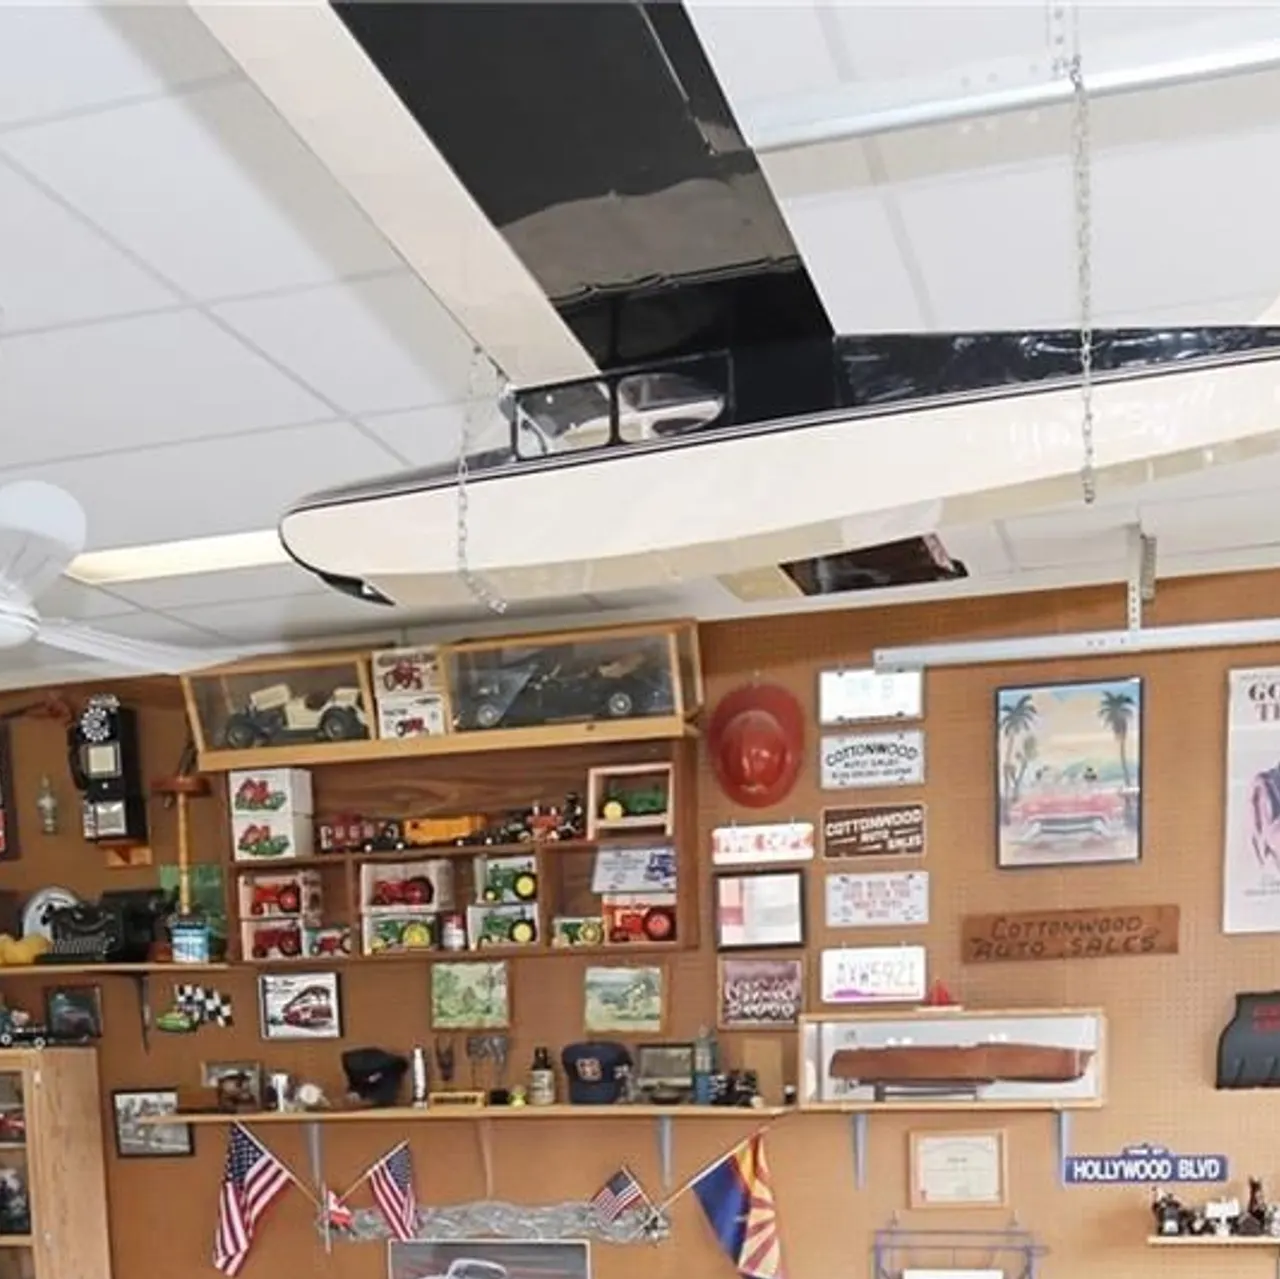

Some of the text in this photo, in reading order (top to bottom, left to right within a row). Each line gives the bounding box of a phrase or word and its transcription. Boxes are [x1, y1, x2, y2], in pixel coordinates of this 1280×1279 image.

[825, 742, 919, 768] COTTONWOOD
[825, 807, 924, 837] COTTONWOOD
[991, 915, 1144, 941] COTTONWOOD
[970, 935, 1158, 961] AUTO SALES
[1073, 1158, 1221, 1180] HOLLYWOOD BLVD
